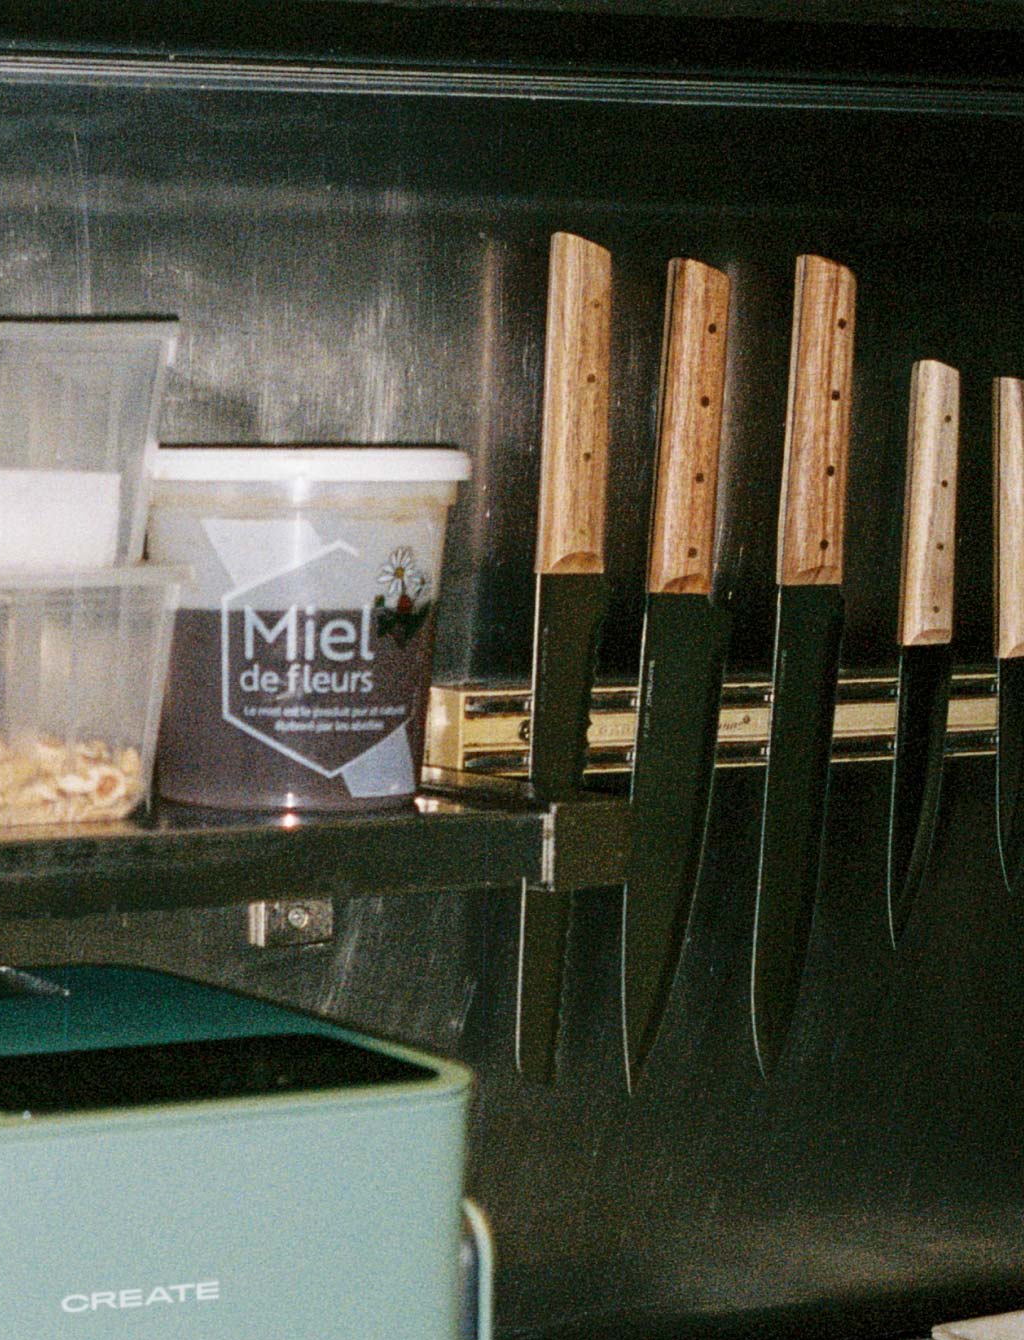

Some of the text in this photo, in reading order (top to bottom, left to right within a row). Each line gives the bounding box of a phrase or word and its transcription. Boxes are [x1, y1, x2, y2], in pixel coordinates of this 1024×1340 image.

[244, 604, 375, 662] Miel
[239, 663, 374, 699] de fleurs
[60, 1281, 220, 1312] CREATE
